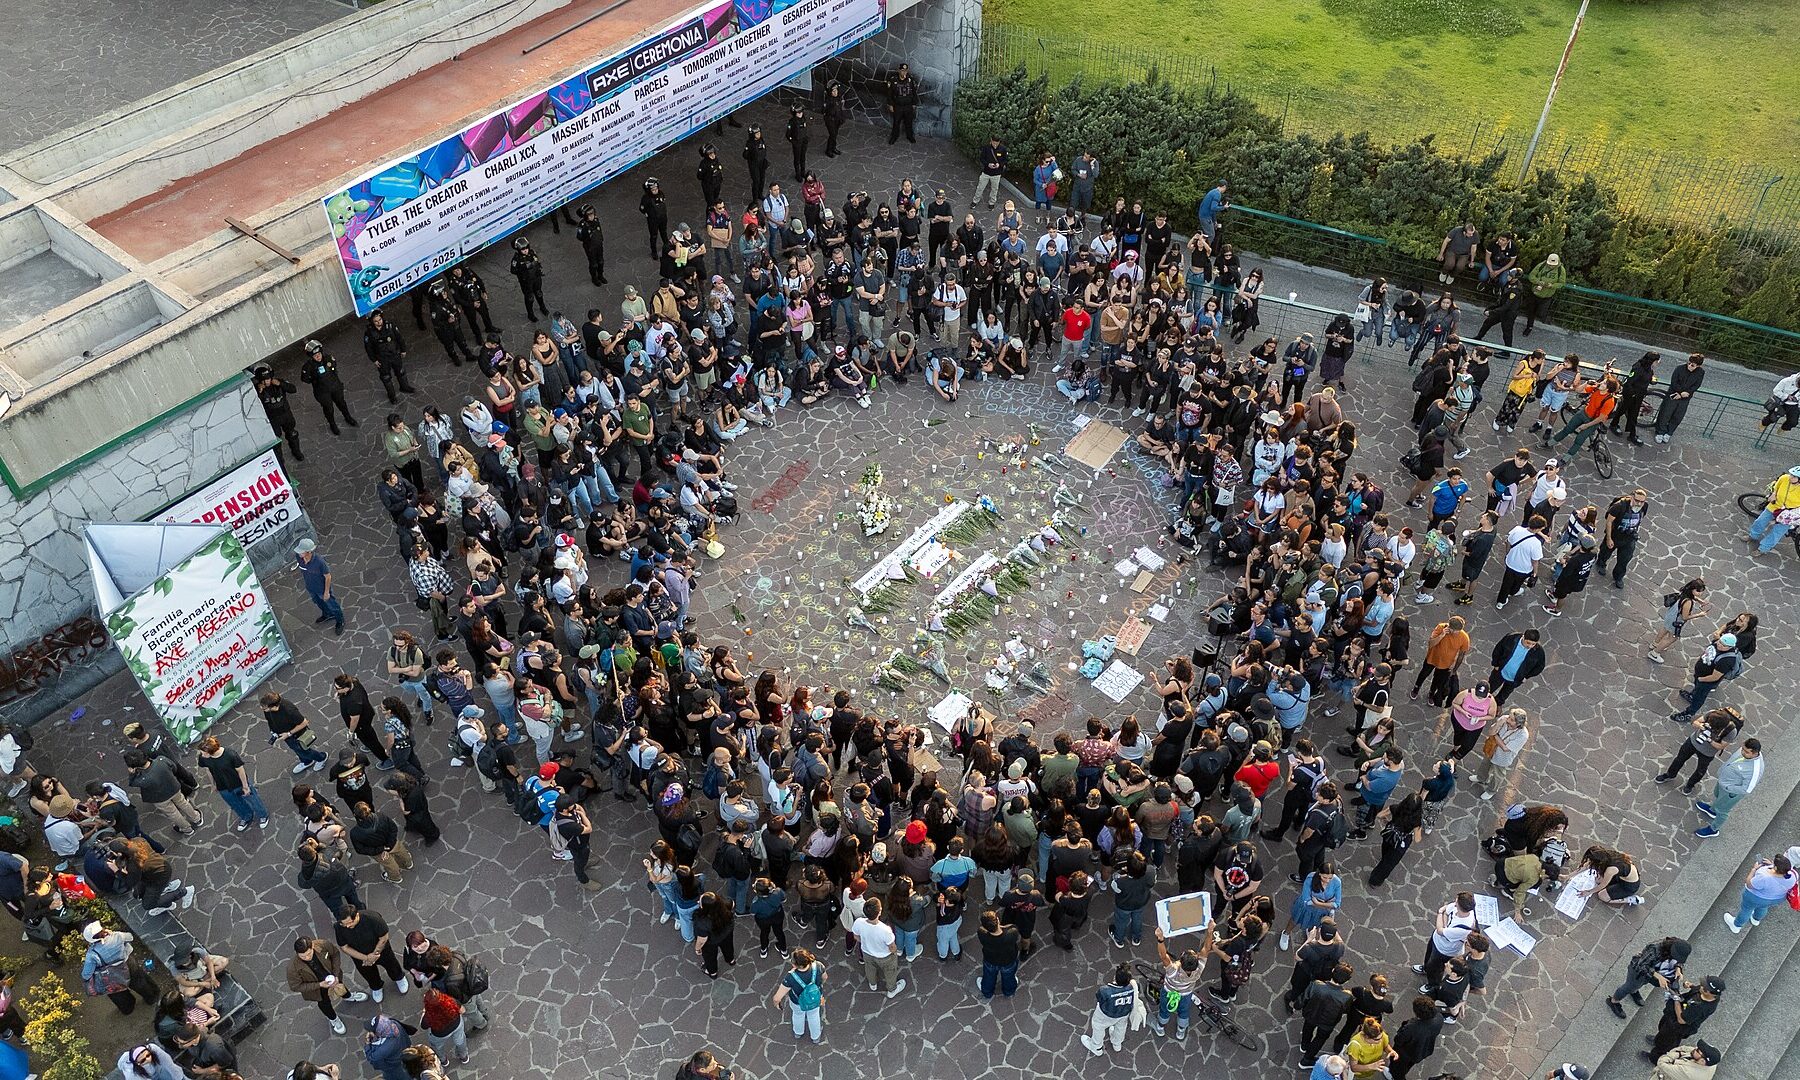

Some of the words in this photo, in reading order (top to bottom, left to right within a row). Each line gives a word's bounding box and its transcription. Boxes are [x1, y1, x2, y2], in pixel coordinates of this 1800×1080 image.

[593, 62, 630, 92] AXE
[634, 26, 703, 70] CEREMONIA
[379, 236, 396, 249] COOK
[404, 218, 431, 237] ARTEMAS
[438, 203, 456, 218] BARRY
[458, 194, 473, 208] CAN'T
[474, 186, 490, 199] SWIM
[505, 160, 541, 184] BRUTALISMUS
[541, 153, 554, 165] 3000
[561, 145, 568, 154] ED
[569, 131, 594, 150] MAVERICK
[600, 110, 635, 133] HANUMANKIND
[648, 94, 665, 107] YACHTY
[672, 77, 700, 95] MAGDALENA
[700, 73, 709, 82] BAY
[715, 65, 723, 74] THE
[746, 46, 759, 58] MEME
[759, 42, 768, 51] DEL
[768, 37, 778, 47] REAL
[402, 202, 424, 220] THE
[425, 179, 468, 210] CREATOR
[484, 154, 517, 179] CHARLI
[518, 143, 537, 162] XCX
[551, 116, 590, 144] MASSIVE
[587, 99, 621, 125] ATTACK
[634, 75, 669, 101] PARCELS
[682, 46, 726, 76] TOMORROW
[724, 42, 733, 54] X
[734, 23, 770, 50] TOGETHER
[376, 277, 404, 300] ABRIL
[405, 271, 412, 282] 5
[414, 266, 419, 277] Y
[423, 262, 429, 272] 6
[432, 248, 455, 268] 2025
[191, 469, 285, 523] PENSIÓN
[142, 608, 183, 641] Familia
[147, 598, 216, 651] Bicentenario
[155, 636, 184, 661] Aviso
[184, 592, 242, 638] importante
[155, 643, 188, 677] AXE
[195, 592, 255, 644] ASESINO
[214, 617, 248, 644] Reabrimos
[165, 677, 195, 705] Bere
[204, 633, 247, 668] Miguel
[185, 668, 194, 676] de
[236, 645, 268, 670] todxs
